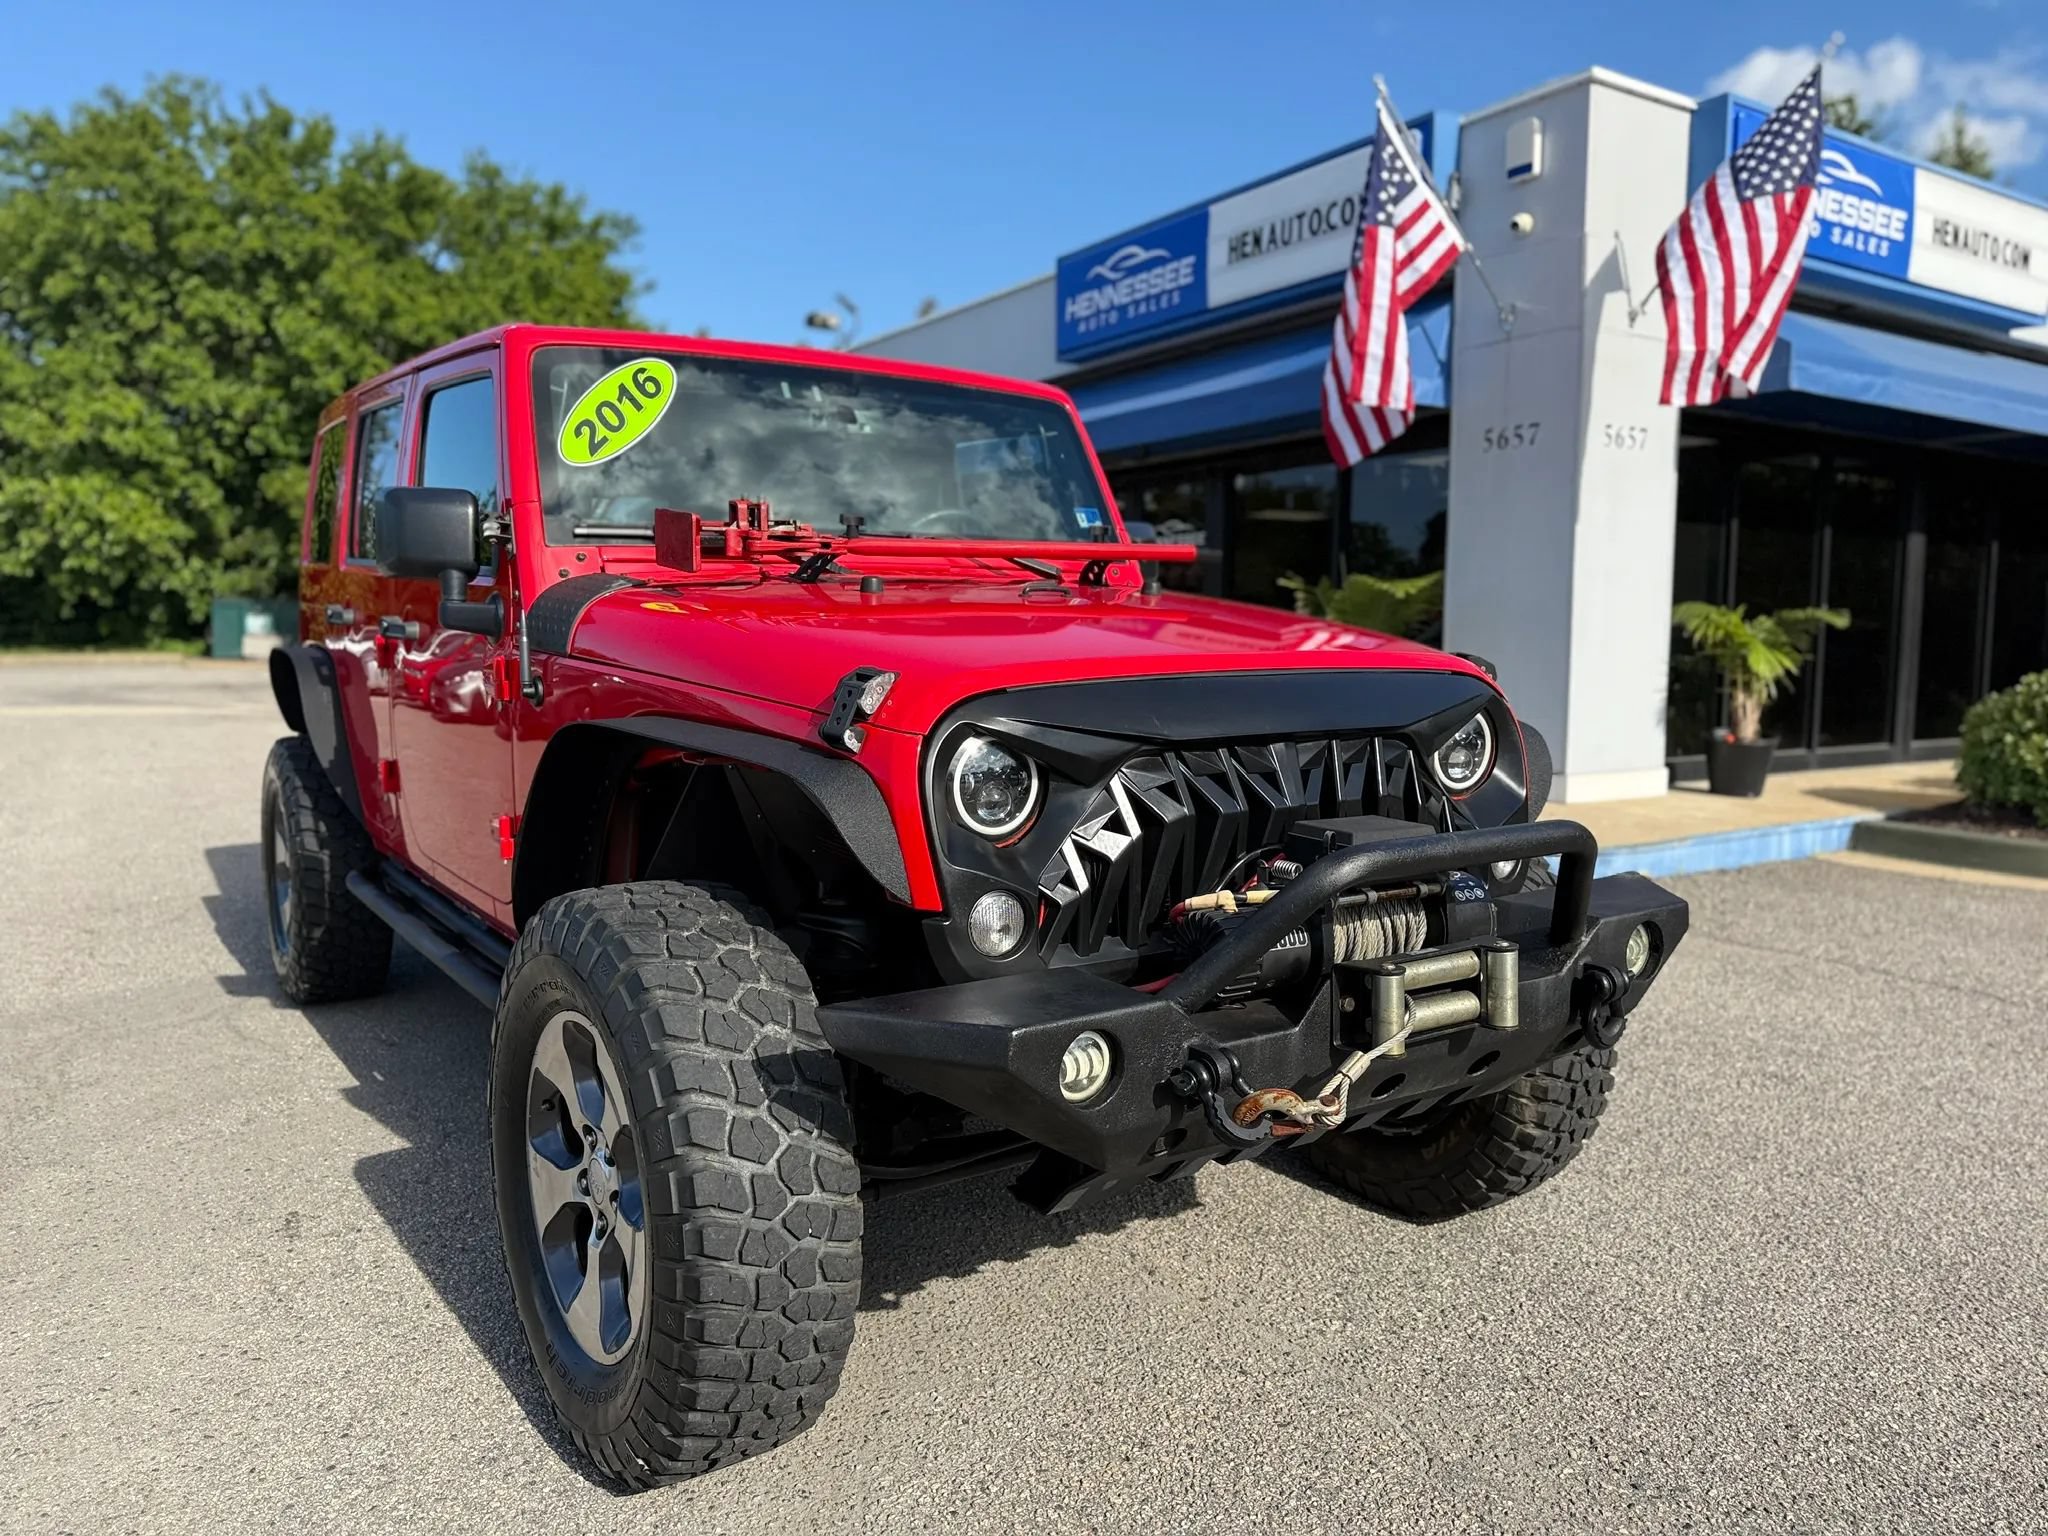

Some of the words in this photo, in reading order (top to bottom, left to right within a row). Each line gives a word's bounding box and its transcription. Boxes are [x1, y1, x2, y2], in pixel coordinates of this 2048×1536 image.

[1228, 196, 1364, 265] HENAUTO.CO
[1808, 187, 1908, 241] NESSEE
[1830, 226, 1889, 257] SALES
[1064, 255, 1197, 323] HENNESSEE
[1078, 309, 1119, 333] AUTO
[1127, 290, 1181, 319] SALES
[573, 367, 662, 457] 2016
[1603, 423, 1649, 449] 5657
[1483, 421, 1541, 453] 5657
